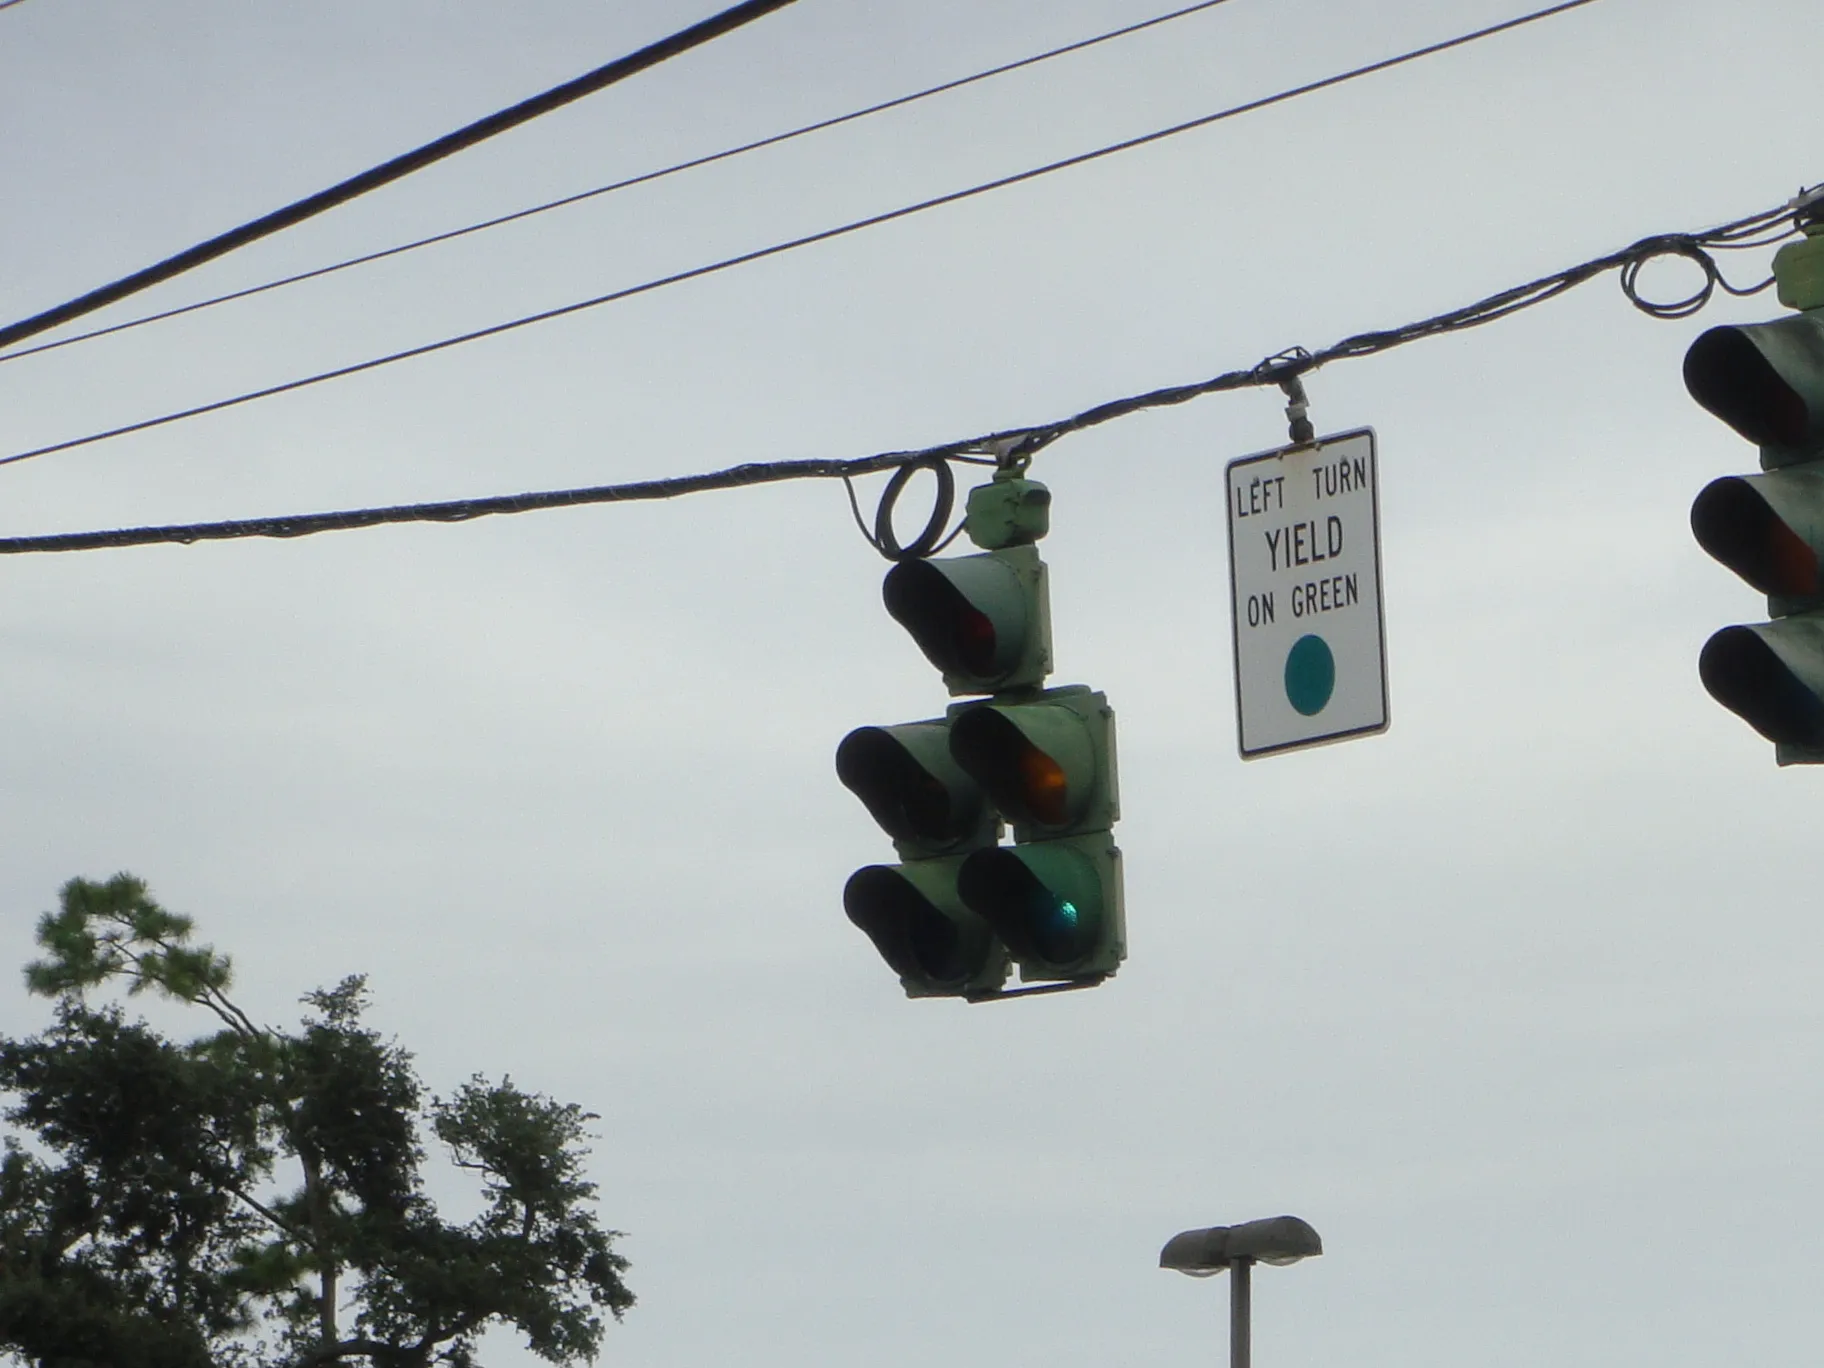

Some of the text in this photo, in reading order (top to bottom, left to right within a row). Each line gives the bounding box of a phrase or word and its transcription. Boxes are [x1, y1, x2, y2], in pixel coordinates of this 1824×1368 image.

[1237, 456, 1366, 518] LEFT TURN
[1264, 515, 1343, 572] YIELD
[1247, 572, 1358, 627] ON GREEN
